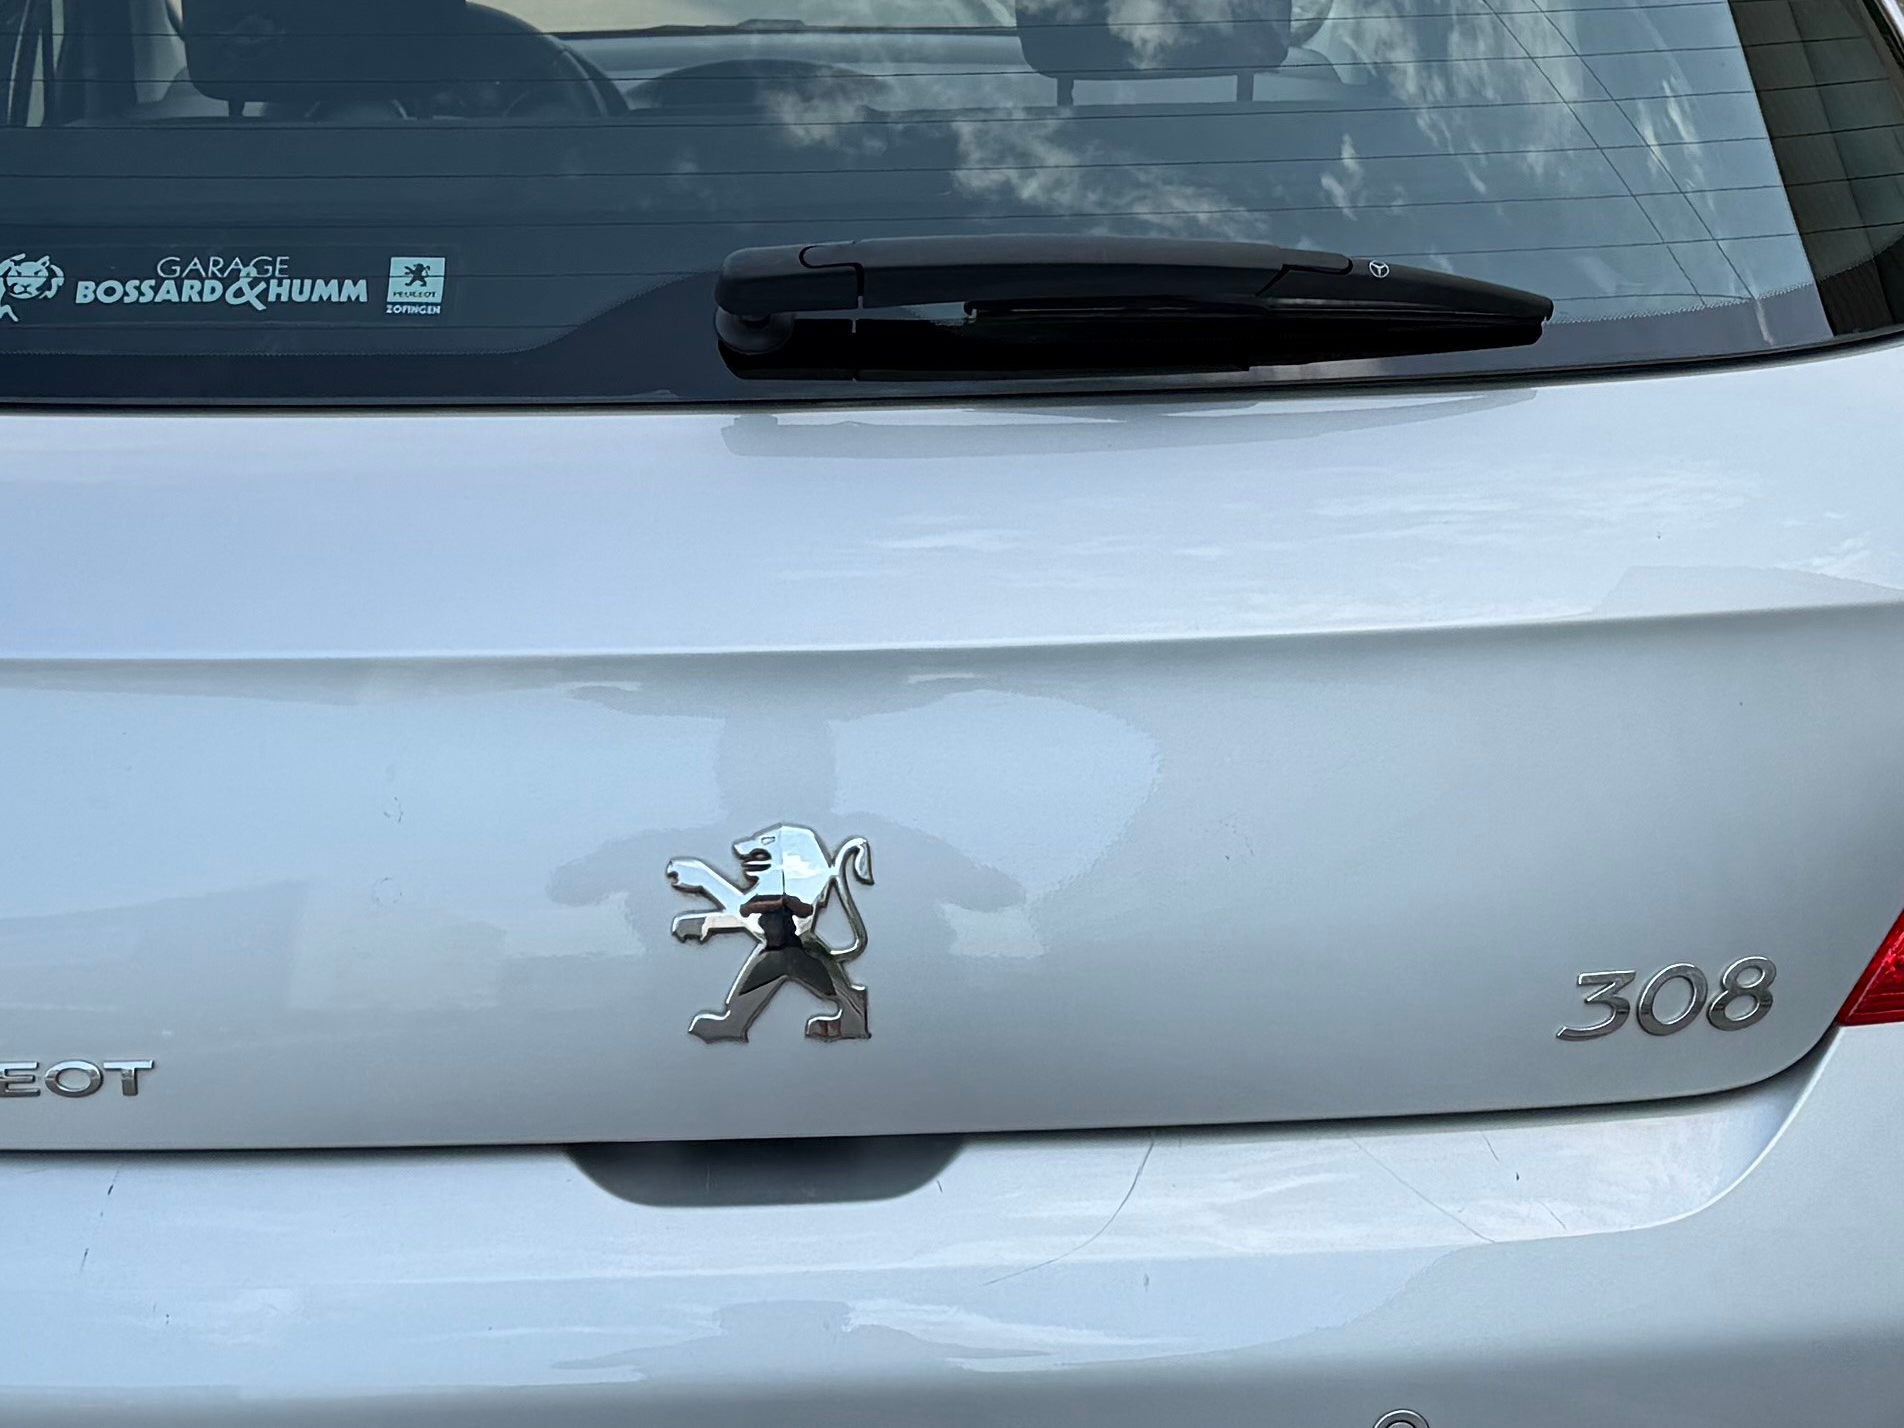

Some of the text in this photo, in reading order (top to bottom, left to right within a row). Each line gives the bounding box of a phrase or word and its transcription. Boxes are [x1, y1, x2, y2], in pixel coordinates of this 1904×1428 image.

[157, 256, 290, 278] GARAGE
[386, 304, 441, 315] ZOFINGEN
[1556, 955, 1777, 1041] 308
